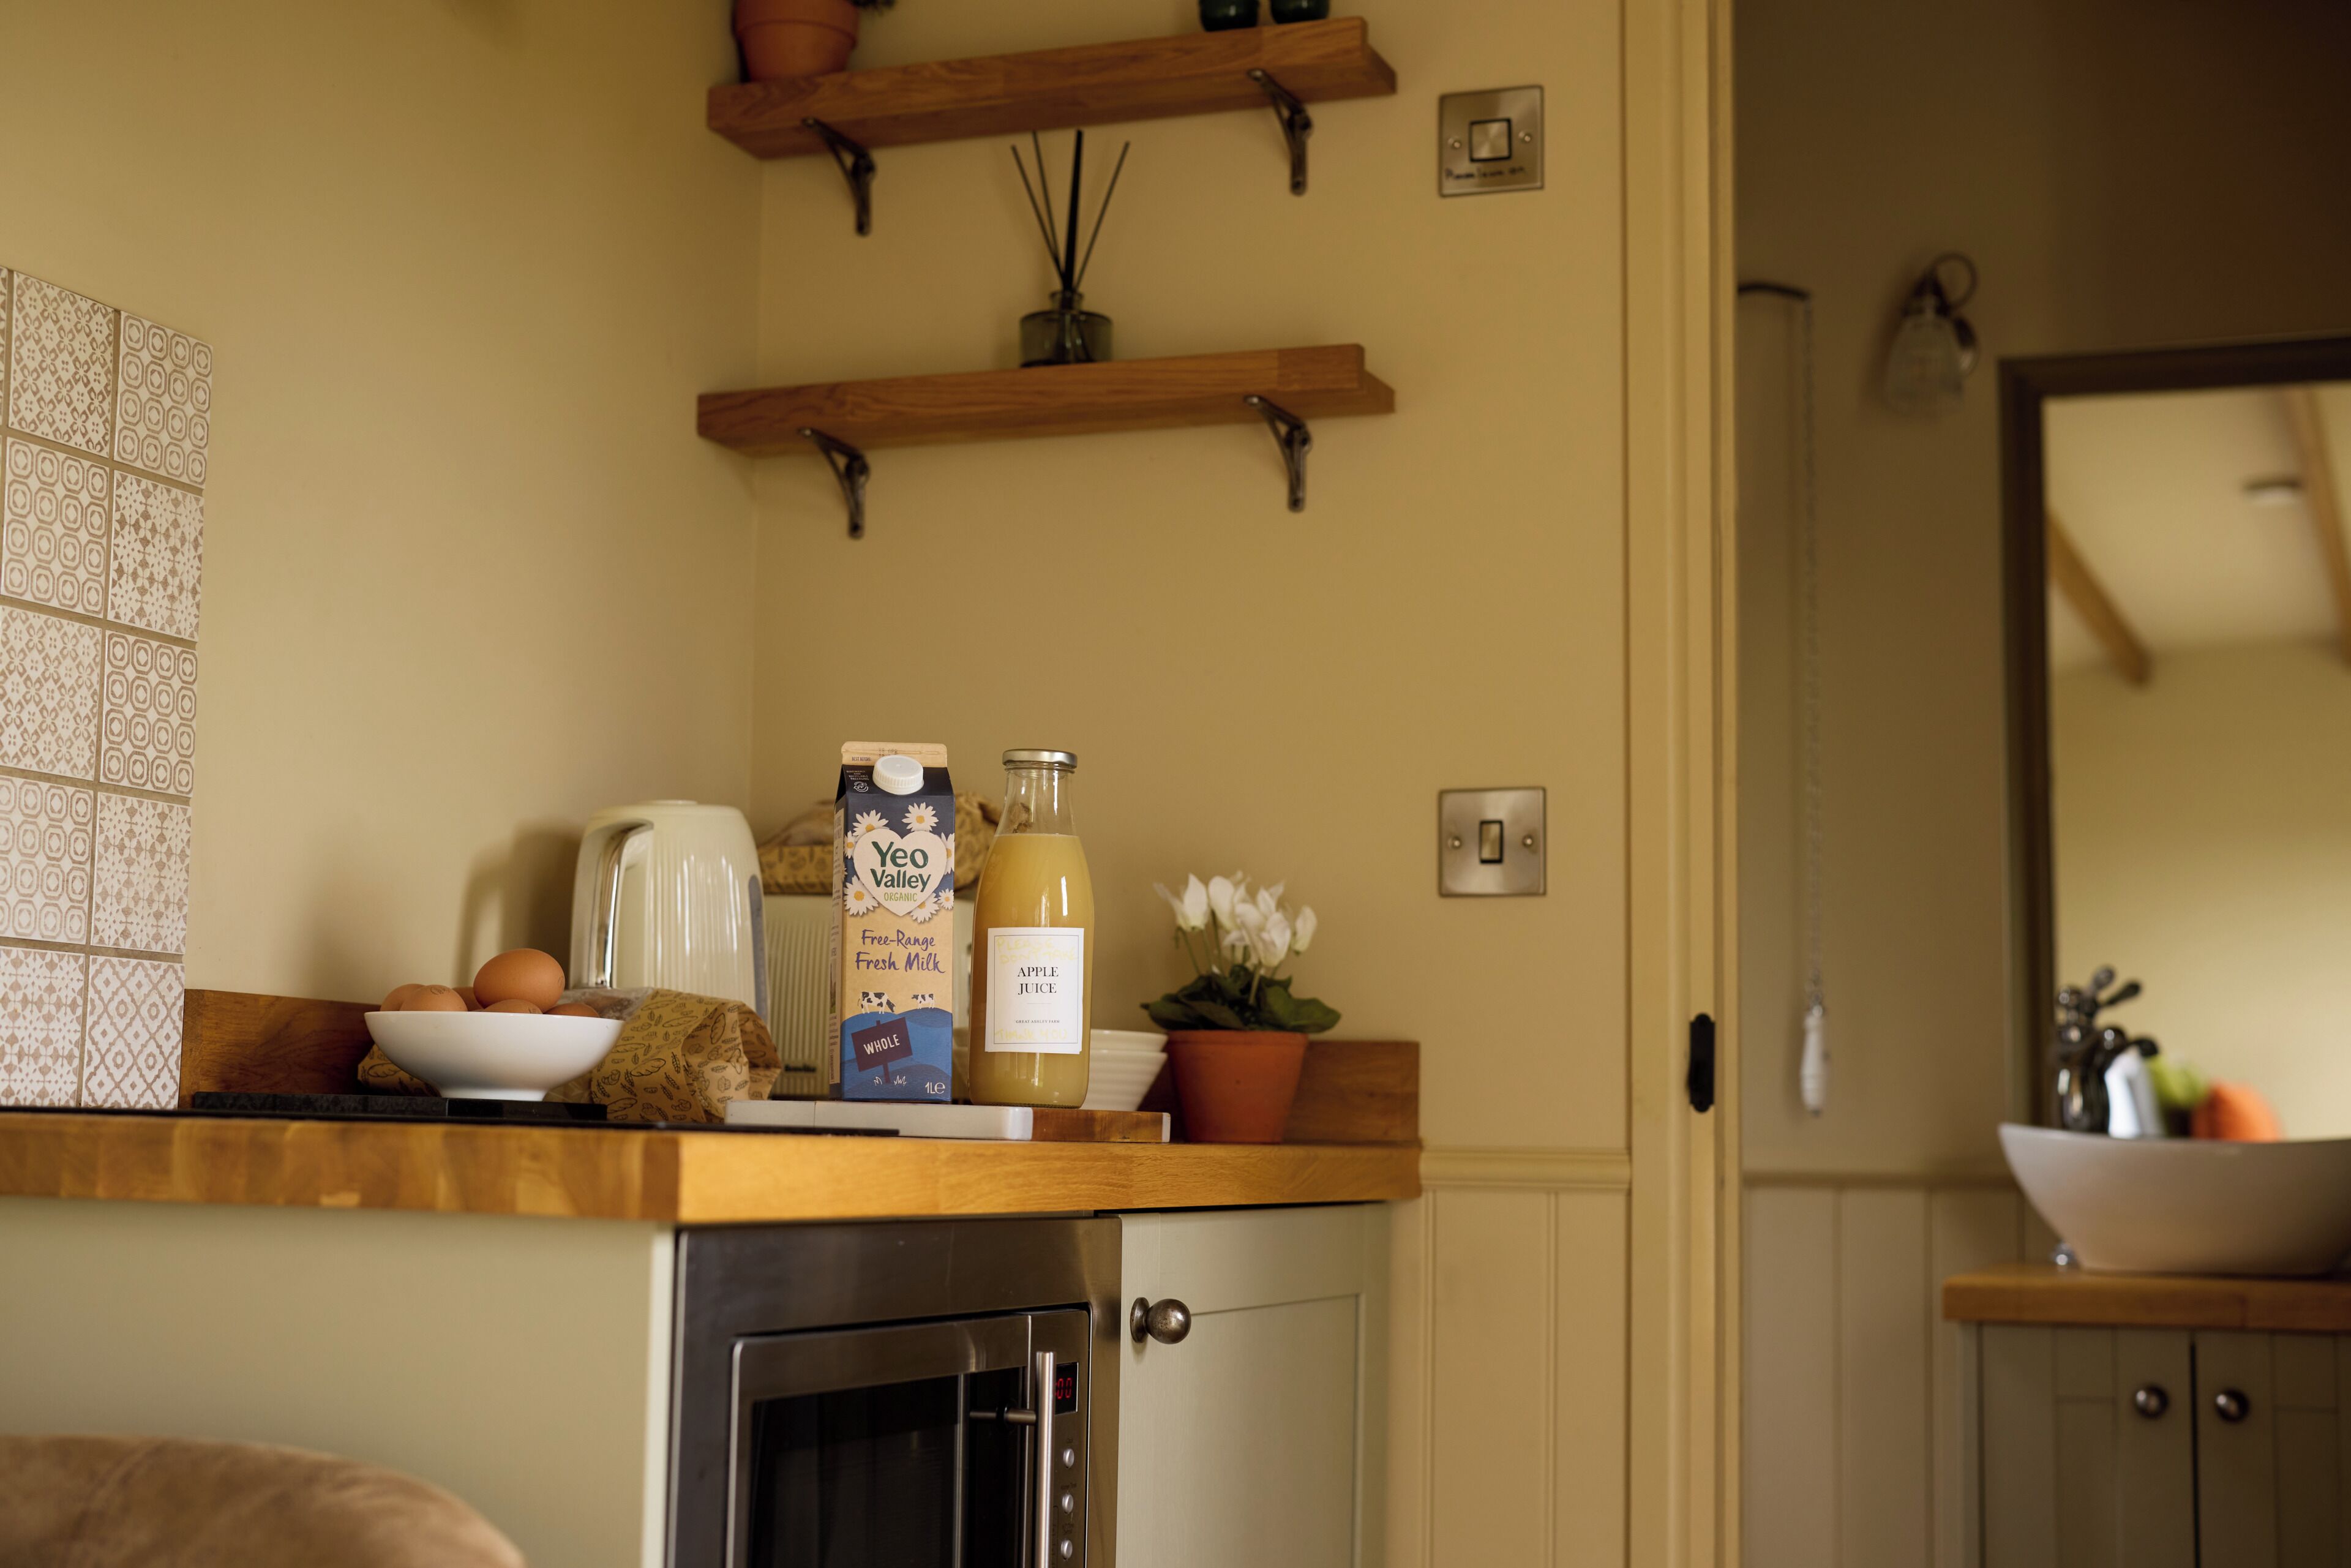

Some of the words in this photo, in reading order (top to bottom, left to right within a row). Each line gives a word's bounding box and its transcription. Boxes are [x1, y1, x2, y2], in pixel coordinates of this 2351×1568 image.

[871, 841, 929, 868] Yeo
[869, 868, 931, 892] Valley
[883, 892, 917, 902] ORGANIC
[861, 929, 936, 951] Free-Range
[855, 951, 899, 971] Fresh
[905, 951, 946, 973] Milk
[1018, 966, 1059, 977] APPLE
[1018, 983, 1057, 996] JUICE
[863, 1033, 901, 1055] WHOLE
